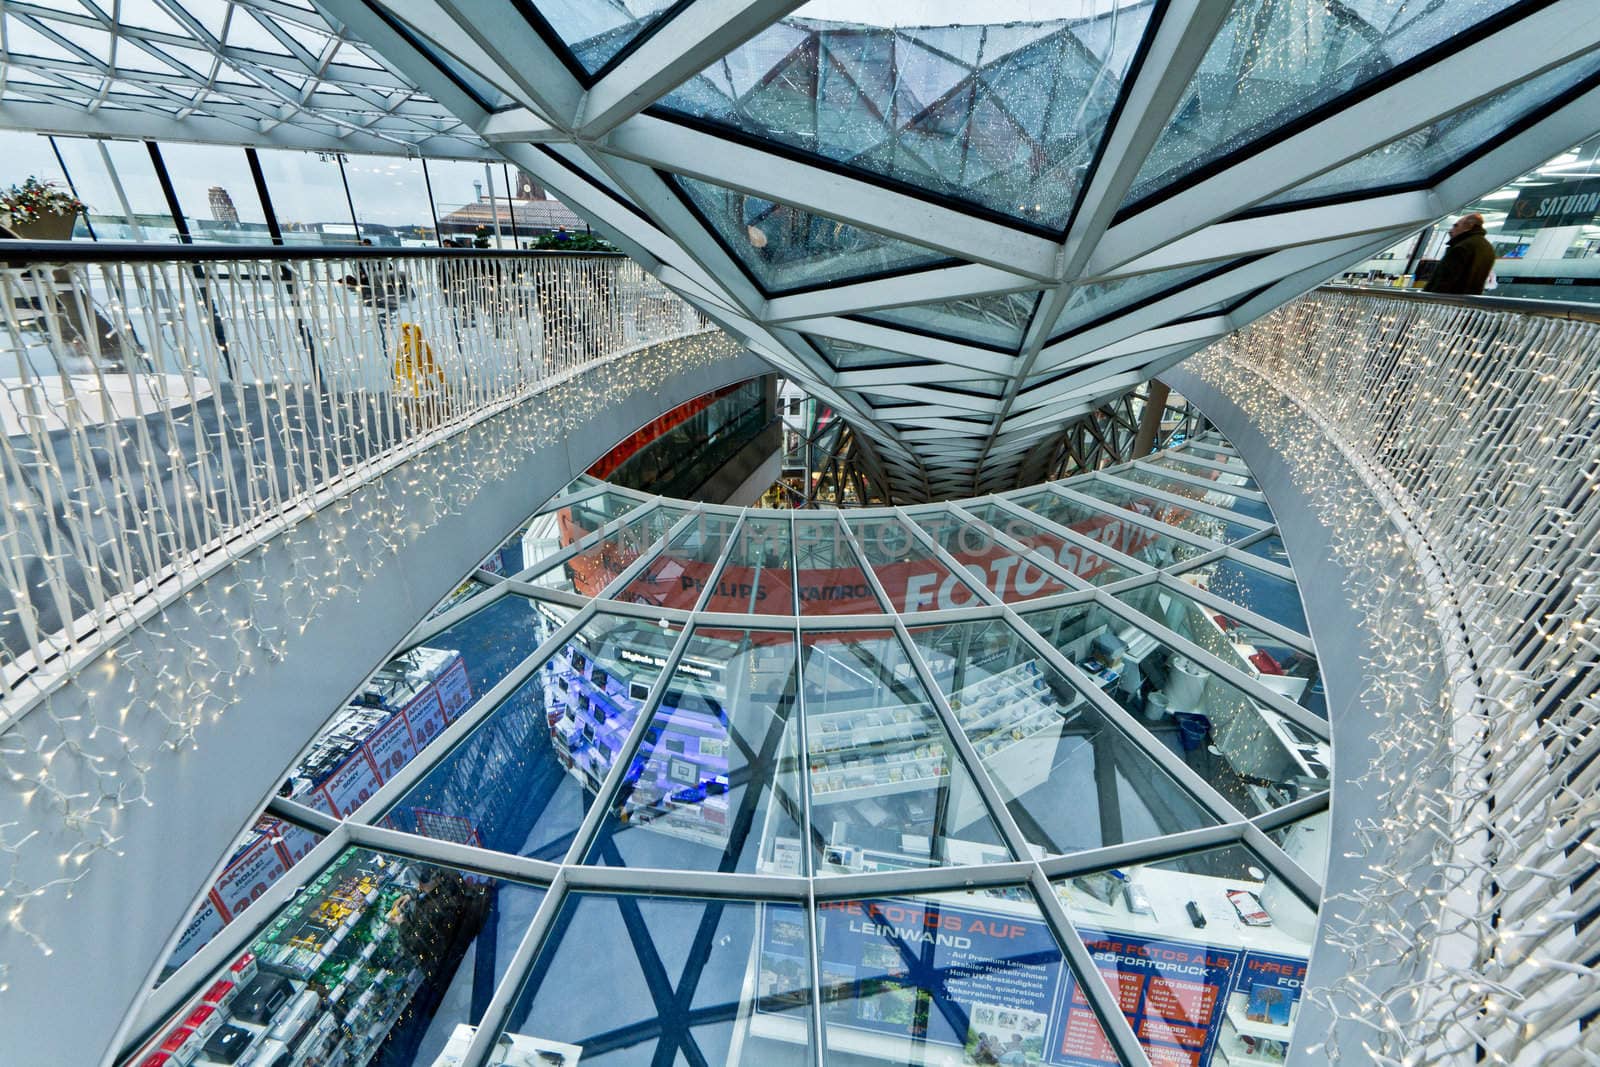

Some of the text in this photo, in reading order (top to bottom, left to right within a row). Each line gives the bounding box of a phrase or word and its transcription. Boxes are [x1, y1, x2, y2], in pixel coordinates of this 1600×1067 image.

[1535, 191, 1600, 217] SATURN
[680, 574, 768, 601] PHLIPS
[868, 903, 963, 931] FOTOS
[967, 919, 1028, 940] AUF
[848, 920, 972, 949] LEINWAND
[951, 951, 1047, 972] Auf Premium Leinwand
[1126, 944, 1189, 962] FOTOS
[1191, 953, 1230, 968] ALS
[1247, 960, 1294, 976] IHRE
[949, 969, 971, 978] Hohe
